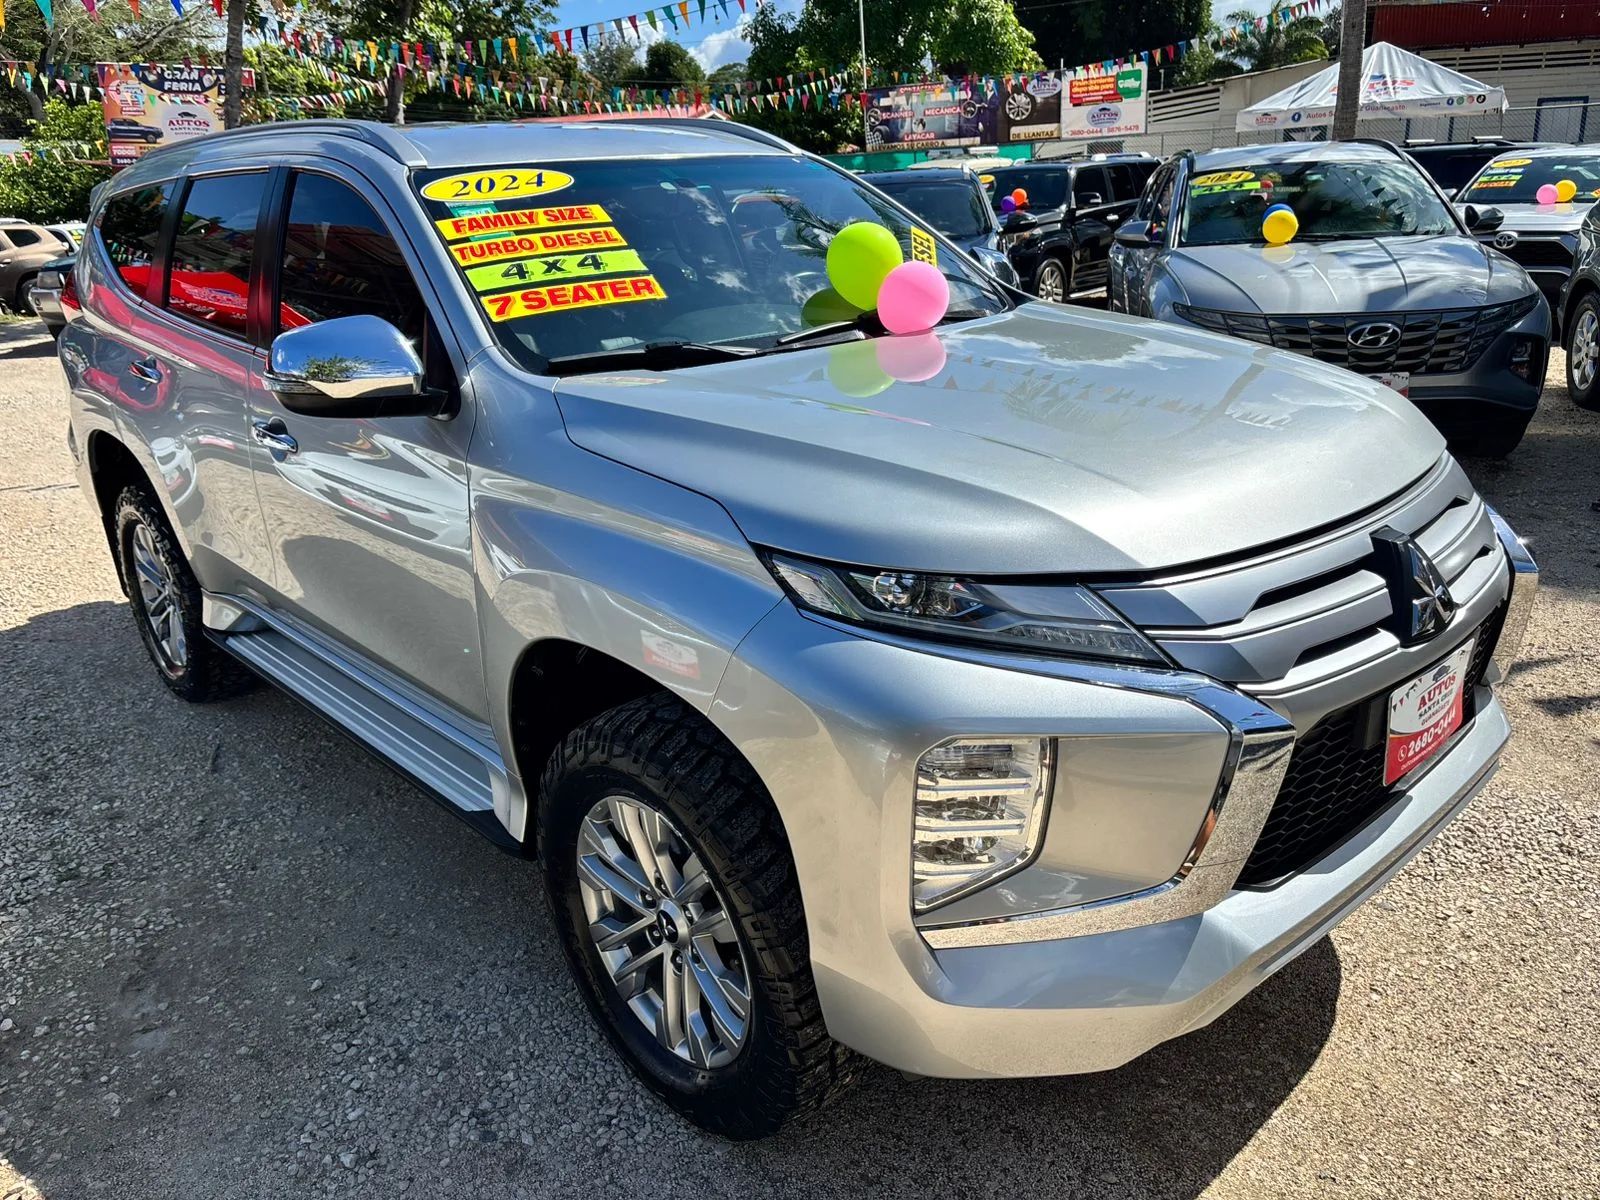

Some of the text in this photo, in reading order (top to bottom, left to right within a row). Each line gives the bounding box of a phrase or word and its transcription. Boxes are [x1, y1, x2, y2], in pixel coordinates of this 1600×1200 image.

[164, 70, 199, 80] GRAN
[164, 81, 202, 92] FERIA
[168, 119, 210, 127] AUTOS
[1024, 130, 1055, 139] LLANTAS
[451, 172, 546, 198] 2024
[451, 211, 538, 235] FAMILY
[543, 206, 596, 223] SIZE
[454, 229, 619, 262] TURBO DIESEL
[488, 278, 656, 317] 7 SEATER
[1417, 671, 1457, 712] AUTOS
